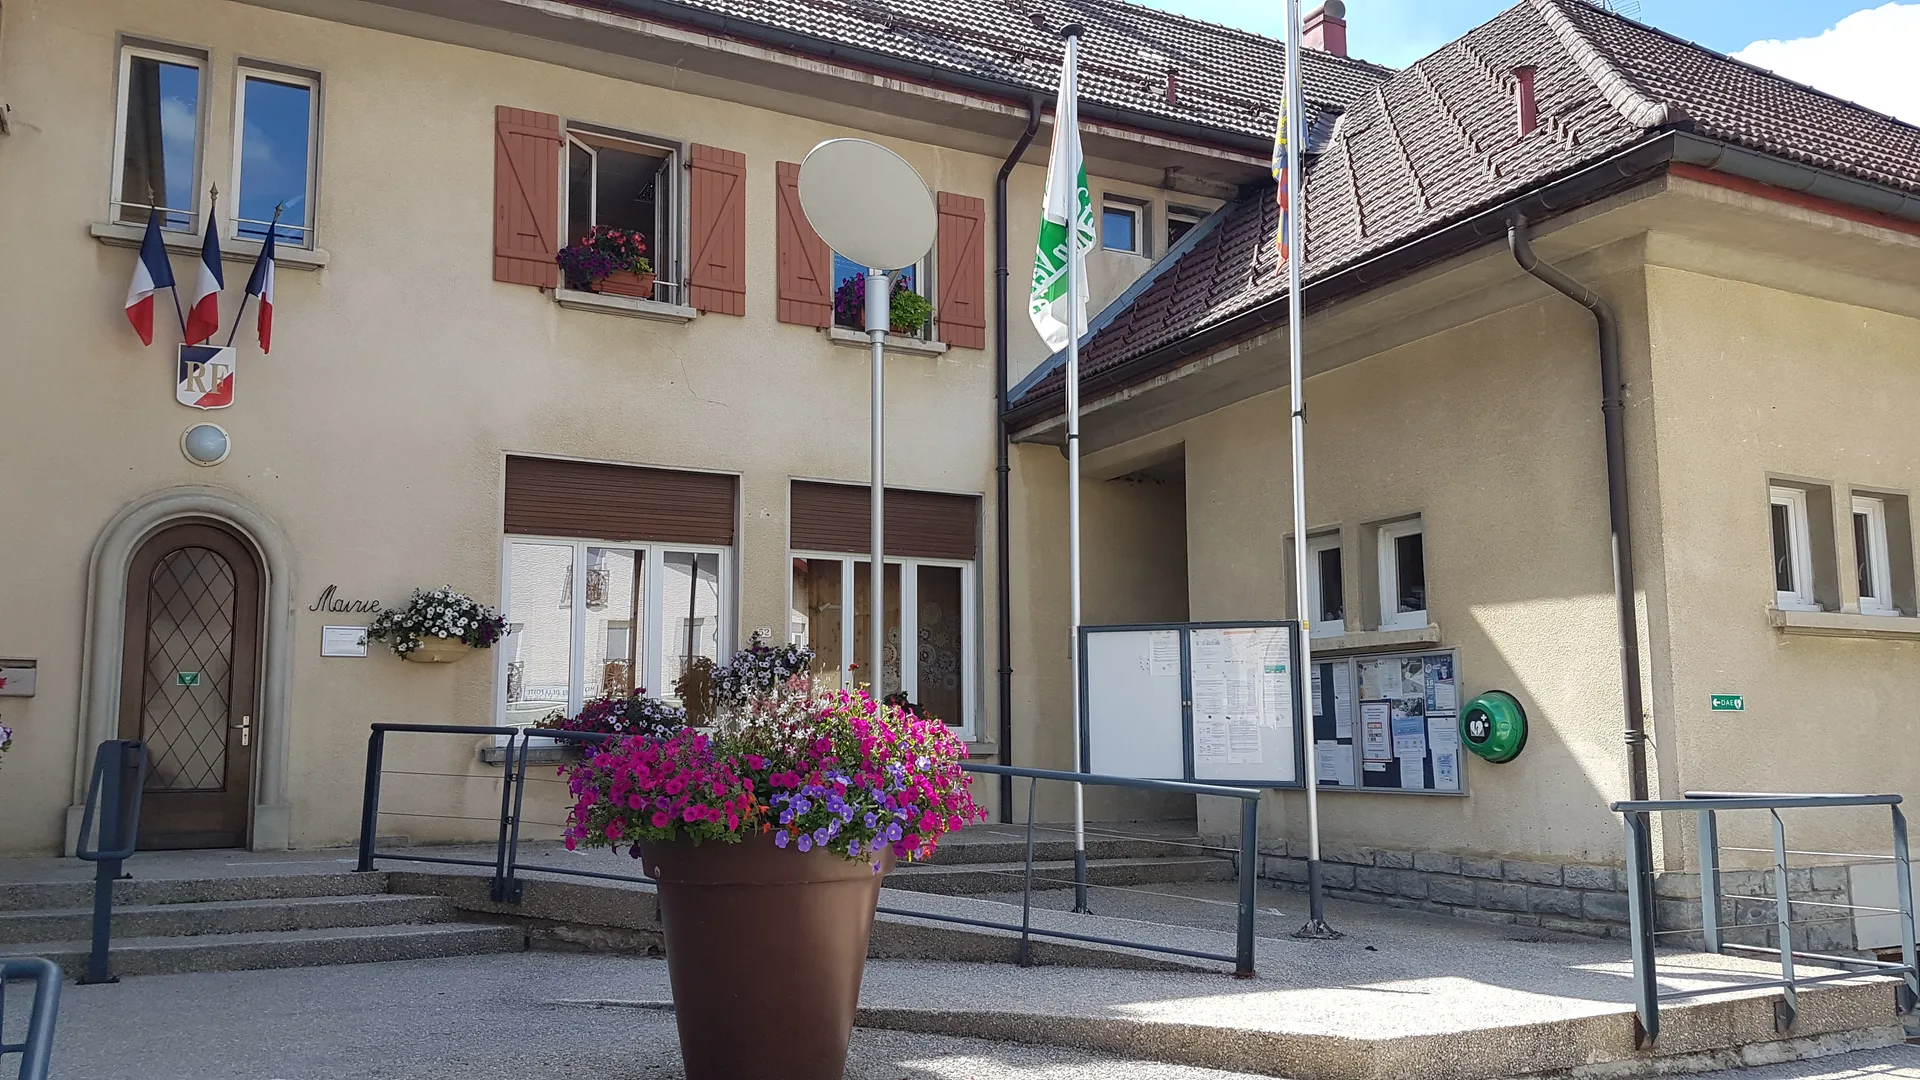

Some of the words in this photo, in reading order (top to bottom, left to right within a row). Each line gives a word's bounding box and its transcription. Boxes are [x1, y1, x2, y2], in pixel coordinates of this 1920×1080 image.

[184, 360, 229, 395] RF
[309, 584, 382, 612] Mairie
[758, 628, 770, 637] 52
